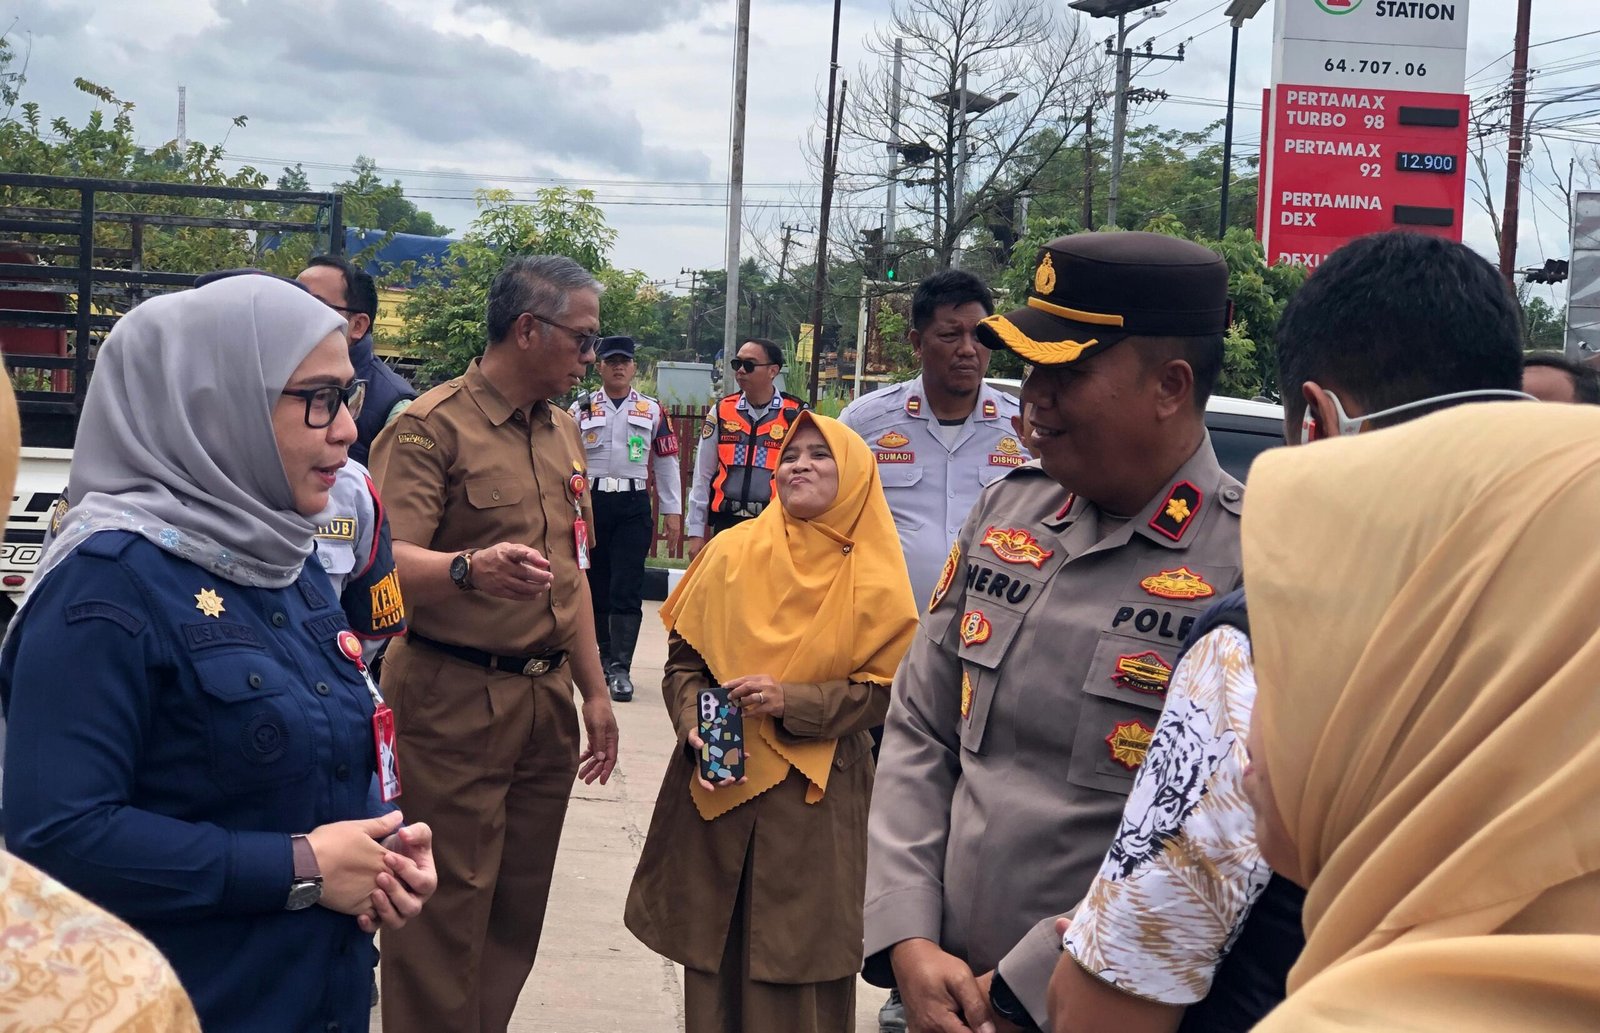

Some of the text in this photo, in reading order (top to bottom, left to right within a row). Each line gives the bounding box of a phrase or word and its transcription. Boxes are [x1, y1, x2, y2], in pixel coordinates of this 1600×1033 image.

[1375, 0, 1455, 21] STATION
[1324, 58, 1427, 77] 64.707.06
[1286, 90, 1386, 110] PERTAMAX
[1286, 110, 1385, 130] TURBO 98
[1284, 138, 1381, 158] PERTAMAX
[1359, 162, 1382, 178] 92
[1400, 154, 1453, 171] 12.900
[1281, 191, 1383, 211] PERTAMINA
[1280, 211, 1317, 227] DEX
[878, 452, 912, 461] SUMADI
[991, 455, 1024, 466] DISHUB
[966, 564, 1031, 605] HERU
